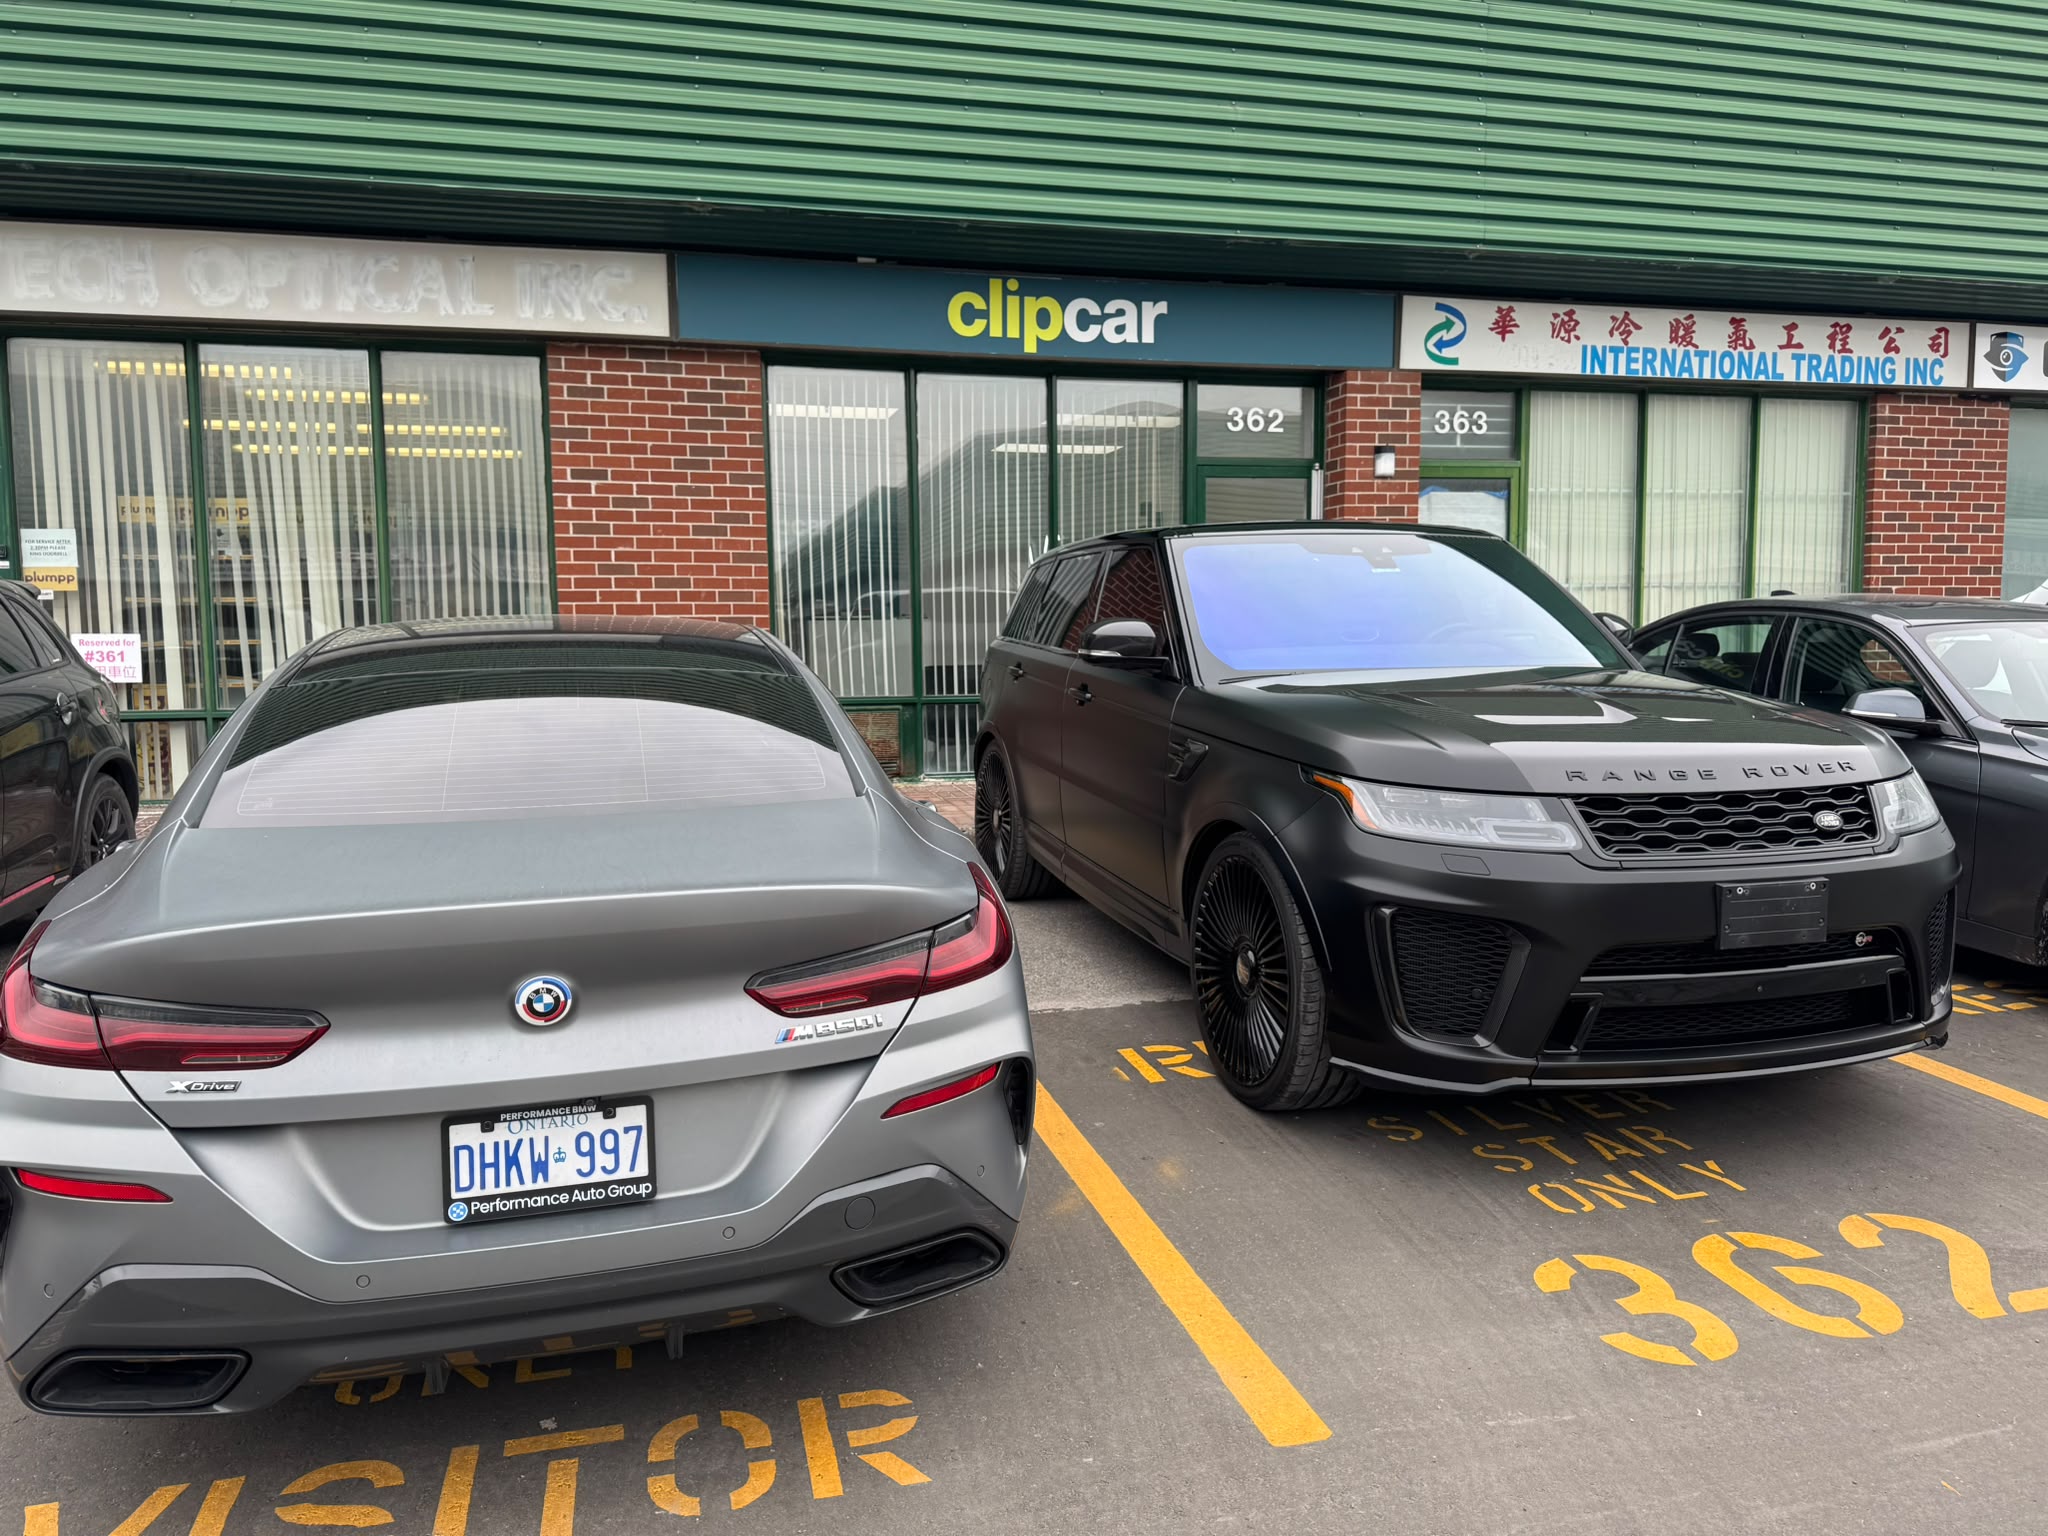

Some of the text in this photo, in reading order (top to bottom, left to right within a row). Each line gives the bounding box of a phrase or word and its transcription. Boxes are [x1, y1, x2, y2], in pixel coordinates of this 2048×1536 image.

[184, 243, 495, 317] OPTICAL
[947, 278, 1168, 354] clipcar
[1580, 344, 1784, 380] INTERNATIONAL
[1791, 352, 1897, 385] TRADING
[1905, 357, 1944, 386] INC
[1226, 407, 1285, 433] 362
[1433, 410, 1488, 435] 363
[25, 571, 75, 584] plumpp
[79, 639, 135, 647] Reserved for
[84, 650, 125, 663] #361
[1565, 760, 1857, 782] RANGE ROVER
[528, 987, 558, 1000] BMW
[500, 1104, 597, 1121] PERFORMANCE BMW
[507, 1112, 589, 1135] ONTARIO
[1367, 1091, 1676, 1143] SILVER
[453, 1125, 643, 1193] DHKW 997
[1472, 1125, 1694, 1172] STAR
[470, 1182, 653, 1215] Performance Auto Group
[1528, 1160, 1747, 1214] ONLY
[1533, 1212, 2048, 1366] 362
